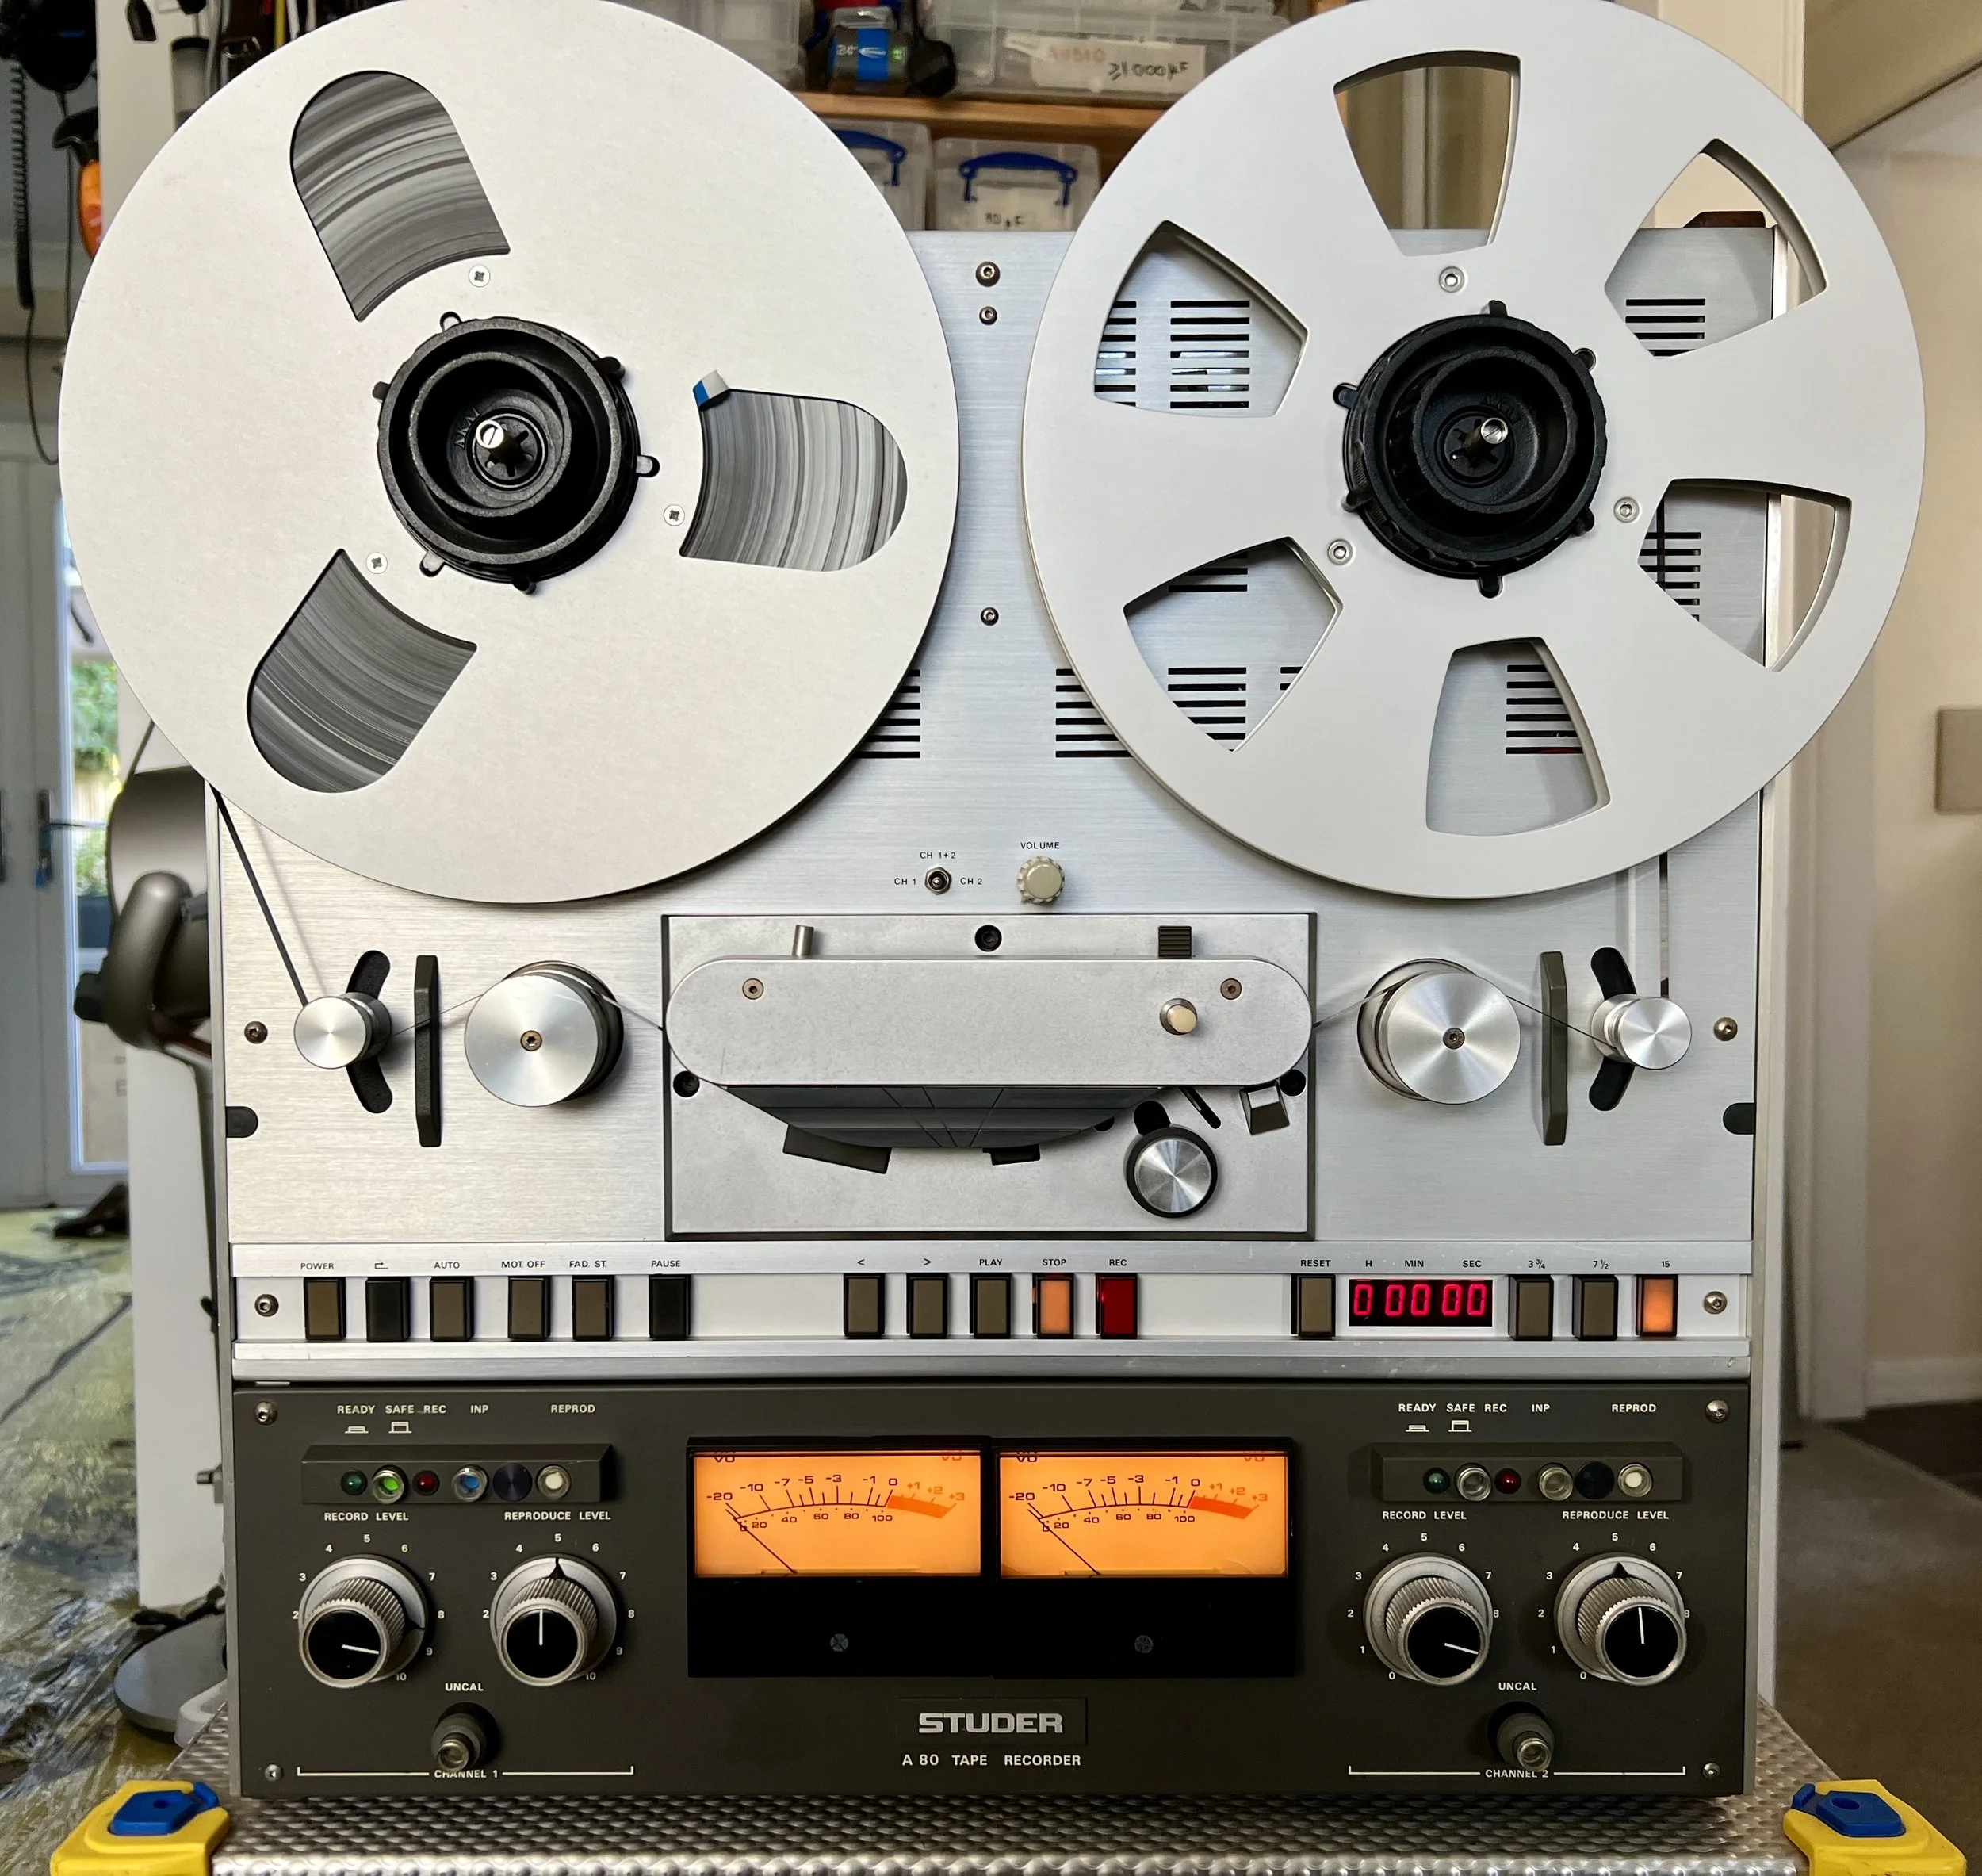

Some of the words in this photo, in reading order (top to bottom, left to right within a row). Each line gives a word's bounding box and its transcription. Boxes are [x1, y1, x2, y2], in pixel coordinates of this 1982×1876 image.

[1020, 841, 1060, 850] VOLUME
[920, 851, 933, 860] CH
[893, 877, 908, 886] CH
[526, 1260, 545, 1269] OFF
[1109, 1258, 1127, 1267] REC
[1300, 1259, 1331, 1268] RESET
[1365, 1259, 1372, 1268] H
[1404, 1259, 1424, 1268] MIN
[1528, 1260, 1534, 1269] 3
[337, 1405, 376, 1415] READY
[385, 1404, 415, 1415] SAFE
[423, 1404, 447, 1414] REC
[470, 1404, 489, 1414] INP
[550, 1403, 596, 1414] REPROD
[1398, 1403, 1437, 1412] READY
[1446, 1403, 1475, 1413] SAFE
[1484, 1403, 1507, 1413] REC
[1532, 1403, 1551, 1413] INP
[1611, 1403, 1657, 1413] REPROD
[888, 1477, 898, 1486] 0
[1190, 1478, 1200, 1487] 0
[324, 1512, 369, 1522] RECORD
[376, 1512, 409, 1521] LEVEL
[504, 1511, 572, 1521] REPRODUCE
[579, 1510, 611, 1521] LEVEL
[1382, 1510, 1427, 1520] RECORD
[1433, 1510, 1467, 1520] LEVEL
[1562, 1510, 1629, 1520] REPRODUCE
[1637, 1510, 1670, 1520] LEVEL
[363, 1533, 371, 1543] 5
[554, 1533, 562, 1542] 5
[1421, 1533, 1428, 1541] 5
[1612, 1533, 1619, 1541] 5
[325, 1544, 333, 1553] 4
[401, 1544, 408, 1553] 6
[515, 1544, 523, 1553] 4
[591, 1542, 599, 1552] 6
[1382, 1543, 1390, 1552] 4
[1458, 1543, 1465, 1552] 6
[1572, 1542, 1580, 1552] 4
[1649, 1542, 1656, 1552] 6
[299, 1572, 307, 1582] 3
[428, 1572, 436, 1581] 7
[490, 1572, 497, 1581] 3
[619, 1571, 626, 1580] 7
[1355, 1572, 1362, 1580] 3
[1485, 1571, 1492, 1580] 7
[1546, 1571, 1553, 1580] 3
[1676, 1571, 1683, 1580] 7
[292, 1610, 300, 1620] 2
[438, 1610, 445, 1619] 8
[482, 1609, 490, 1618] 2
[628, 1609, 635, 1618] 8
[1347, 1609, 1354, 1618] 2
[1493, 1609, 1500, 1618] 8
[1537, 1609, 1544, 1618] 2
[426, 1647, 433, 1656] 9
[616, 1646, 623, 1656] 9
[1360, 1645, 1364, 1654] 1
[1551, 1645, 1555, 1654] 1
[1388, 1671, 1396, 1680] 0
[1579, 1671, 1587, 1680] 0
[445, 1682, 484, 1692] UNCAL
[1498, 1682, 1537, 1691] UNCAL
[918, 1712, 1063, 1733] STUDER
[901, 1754, 913, 1766] A
[919, 1753, 939, 1766] 80
[951, 1755, 988, 1766] TAPE
[1004, 1755, 1081, 1766] RECORDER
[492, 1769, 498, 1778] 1
[1485, 1769, 1538, 1778] CHANNEL
[1541, 1768, 1549, 1778] 2
